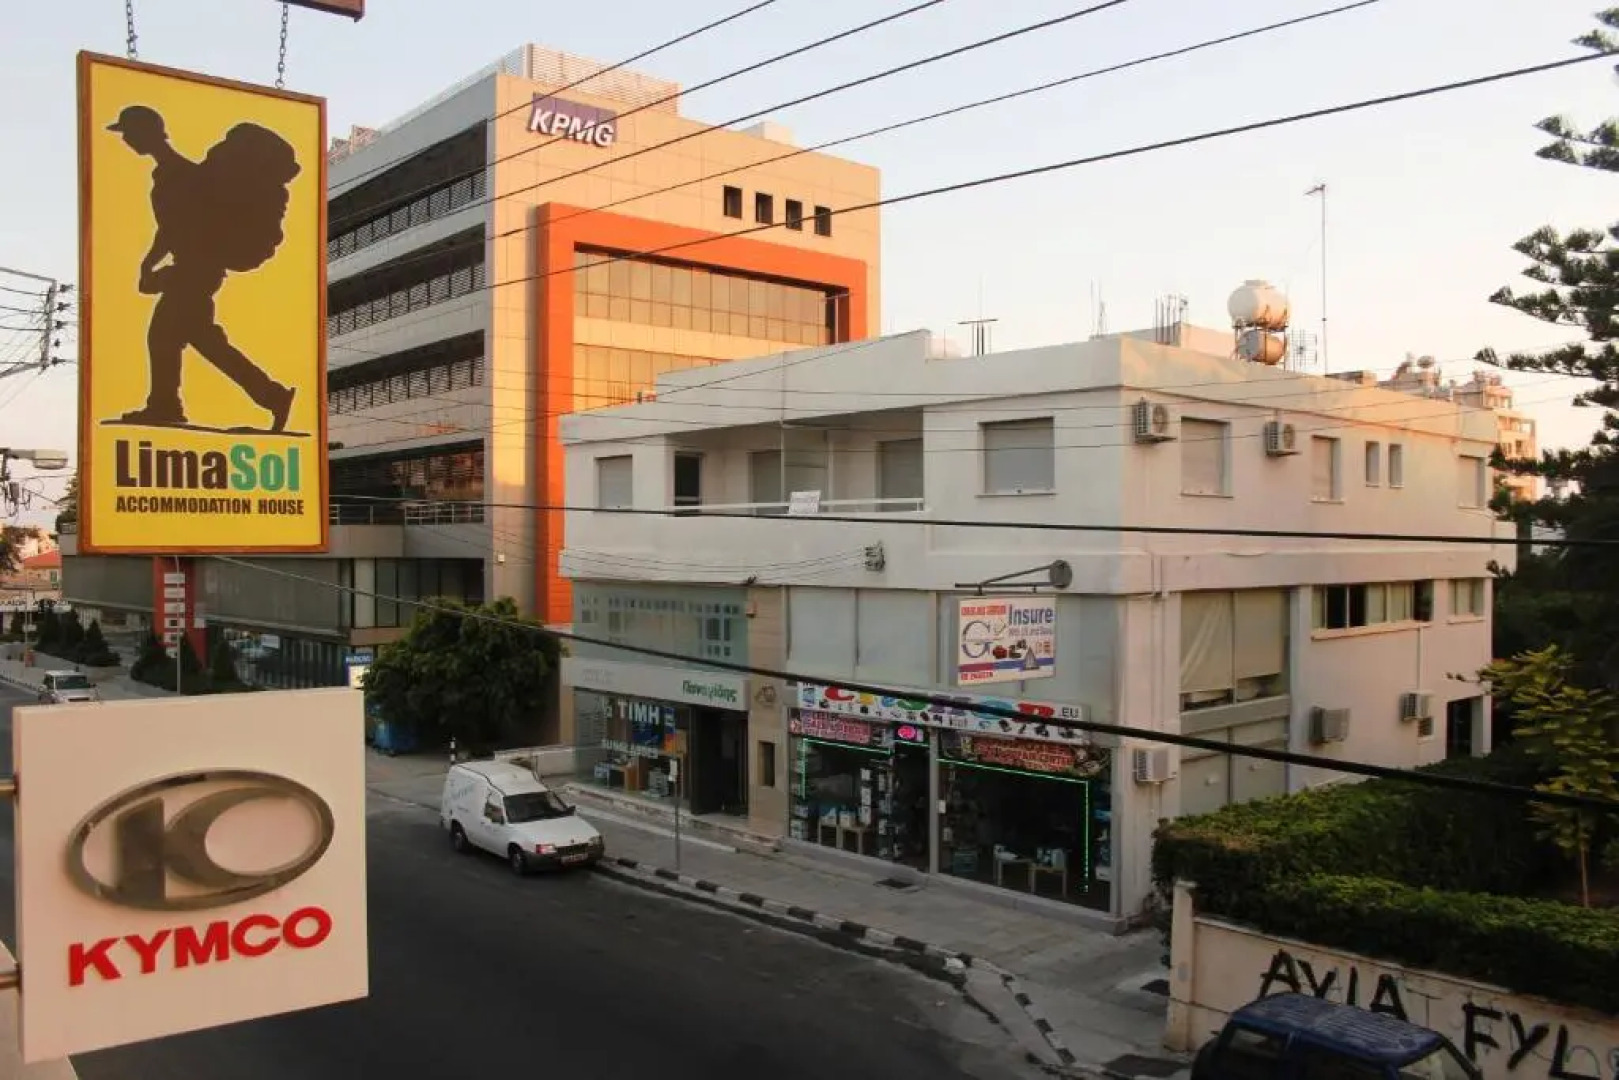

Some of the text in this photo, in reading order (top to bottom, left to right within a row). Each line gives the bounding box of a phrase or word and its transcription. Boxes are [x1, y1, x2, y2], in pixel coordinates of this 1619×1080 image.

[529, 108, 615, 147] KPMG
[115, 439, 300, 492] LimaSol
[115, 495, 304, 515] ACCOMMODATION HOUSE
[1008, 604, 1054, 625] Insure
[68, 906, 333, 987] KYMCO
[1259, 948, 1409, 1022] AYIA
